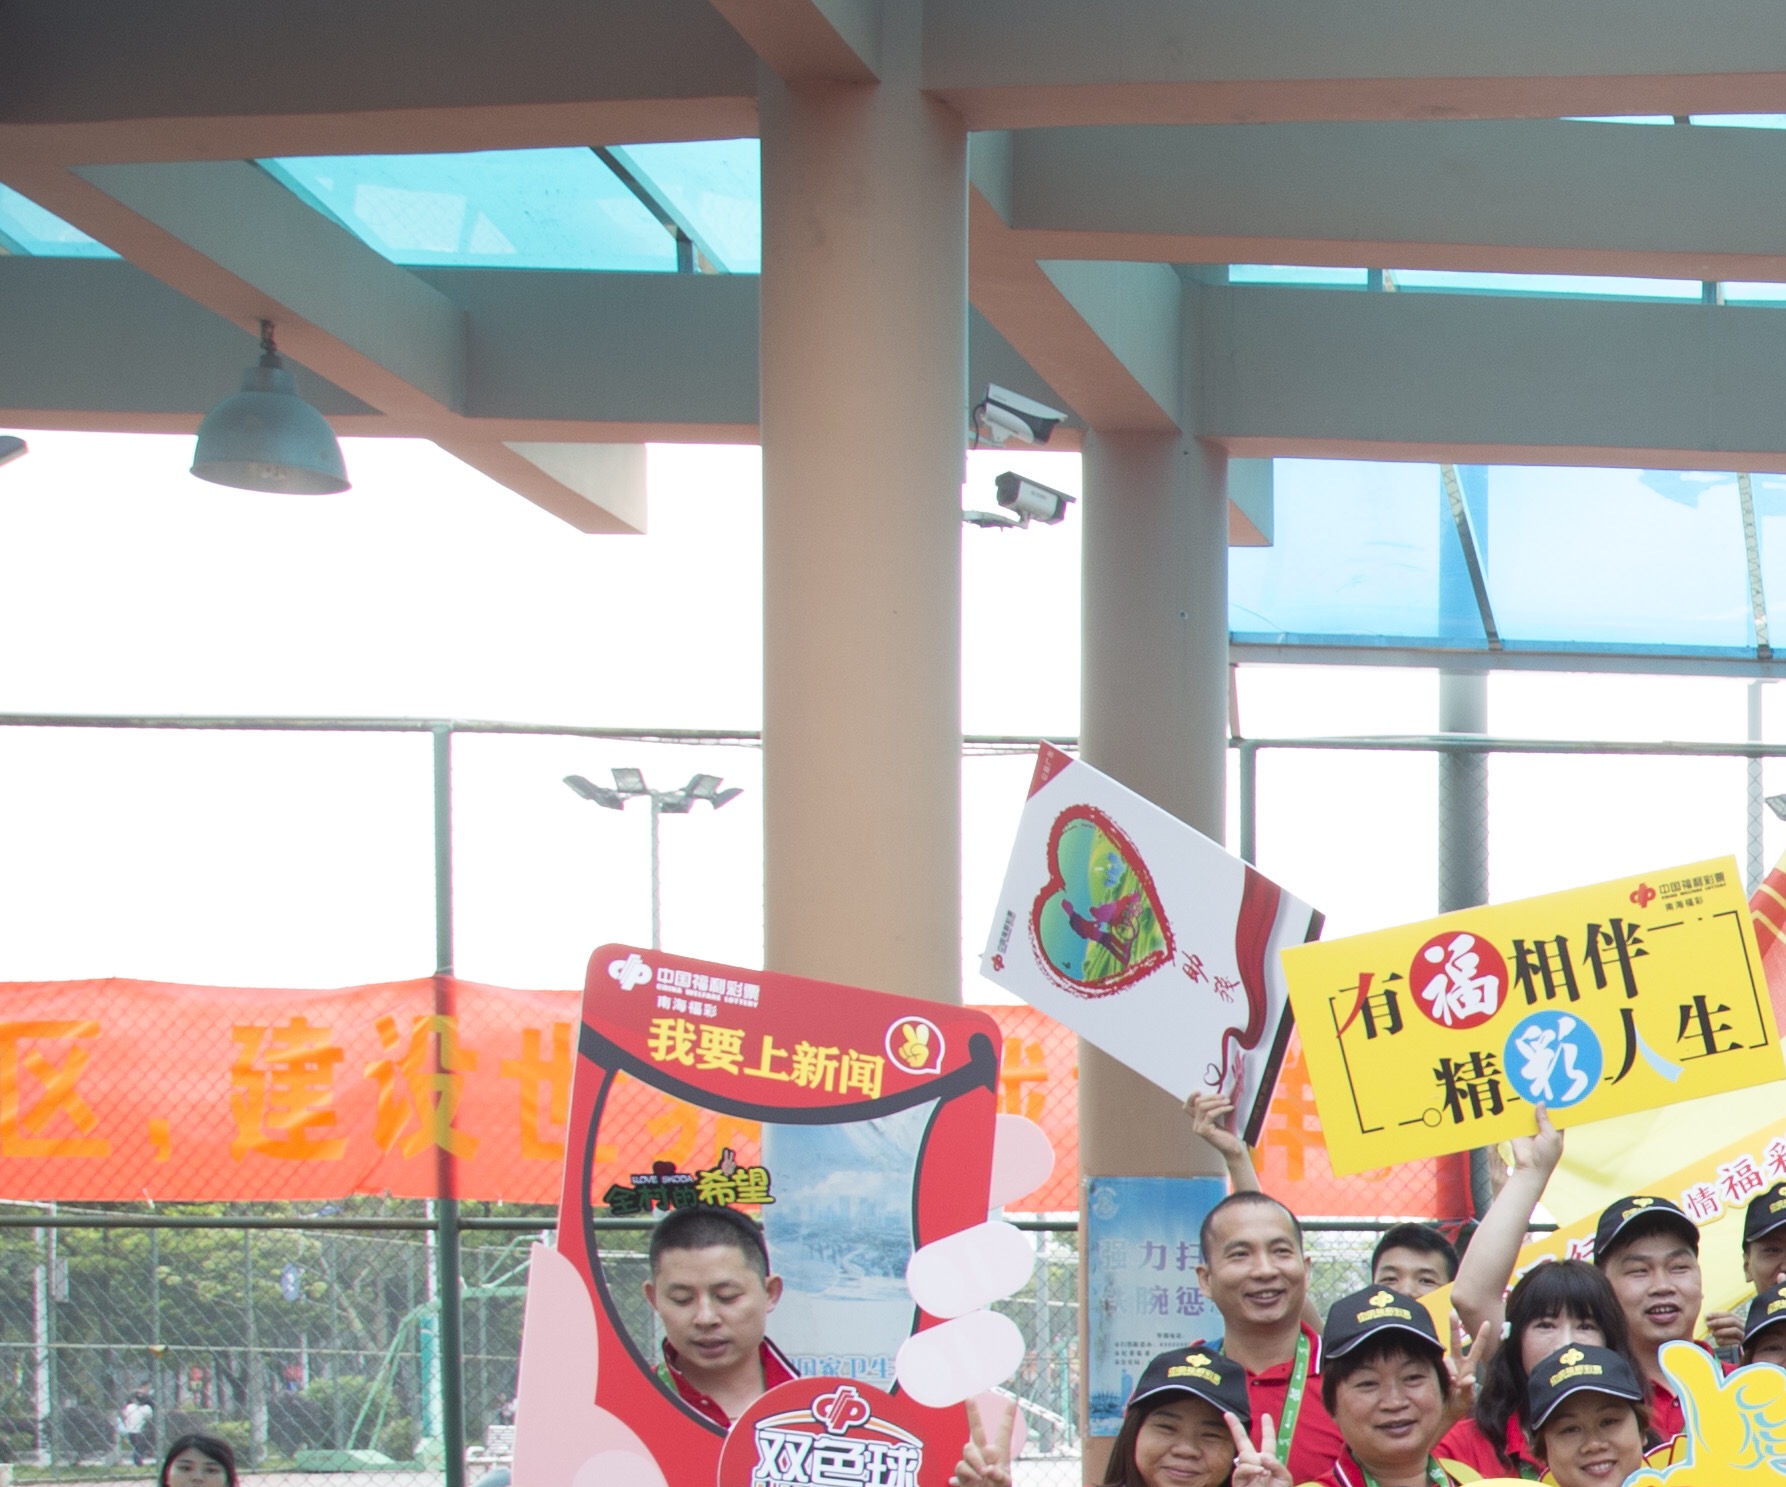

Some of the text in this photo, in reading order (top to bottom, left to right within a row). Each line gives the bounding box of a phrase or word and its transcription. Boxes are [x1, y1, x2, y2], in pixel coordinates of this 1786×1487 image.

[1658, 871, 1726, 895] 中国福利彩票
[656, 967, 761, 1002] 中国福利彩票
[656, 995, 718, 1019] 南海福彩
[1337, 918, 1650, 1040] 有福相伴
[647, 1017, 885, 1100] 我要上新闻
[1432, 995, 1745, 1125] 精彩人生
